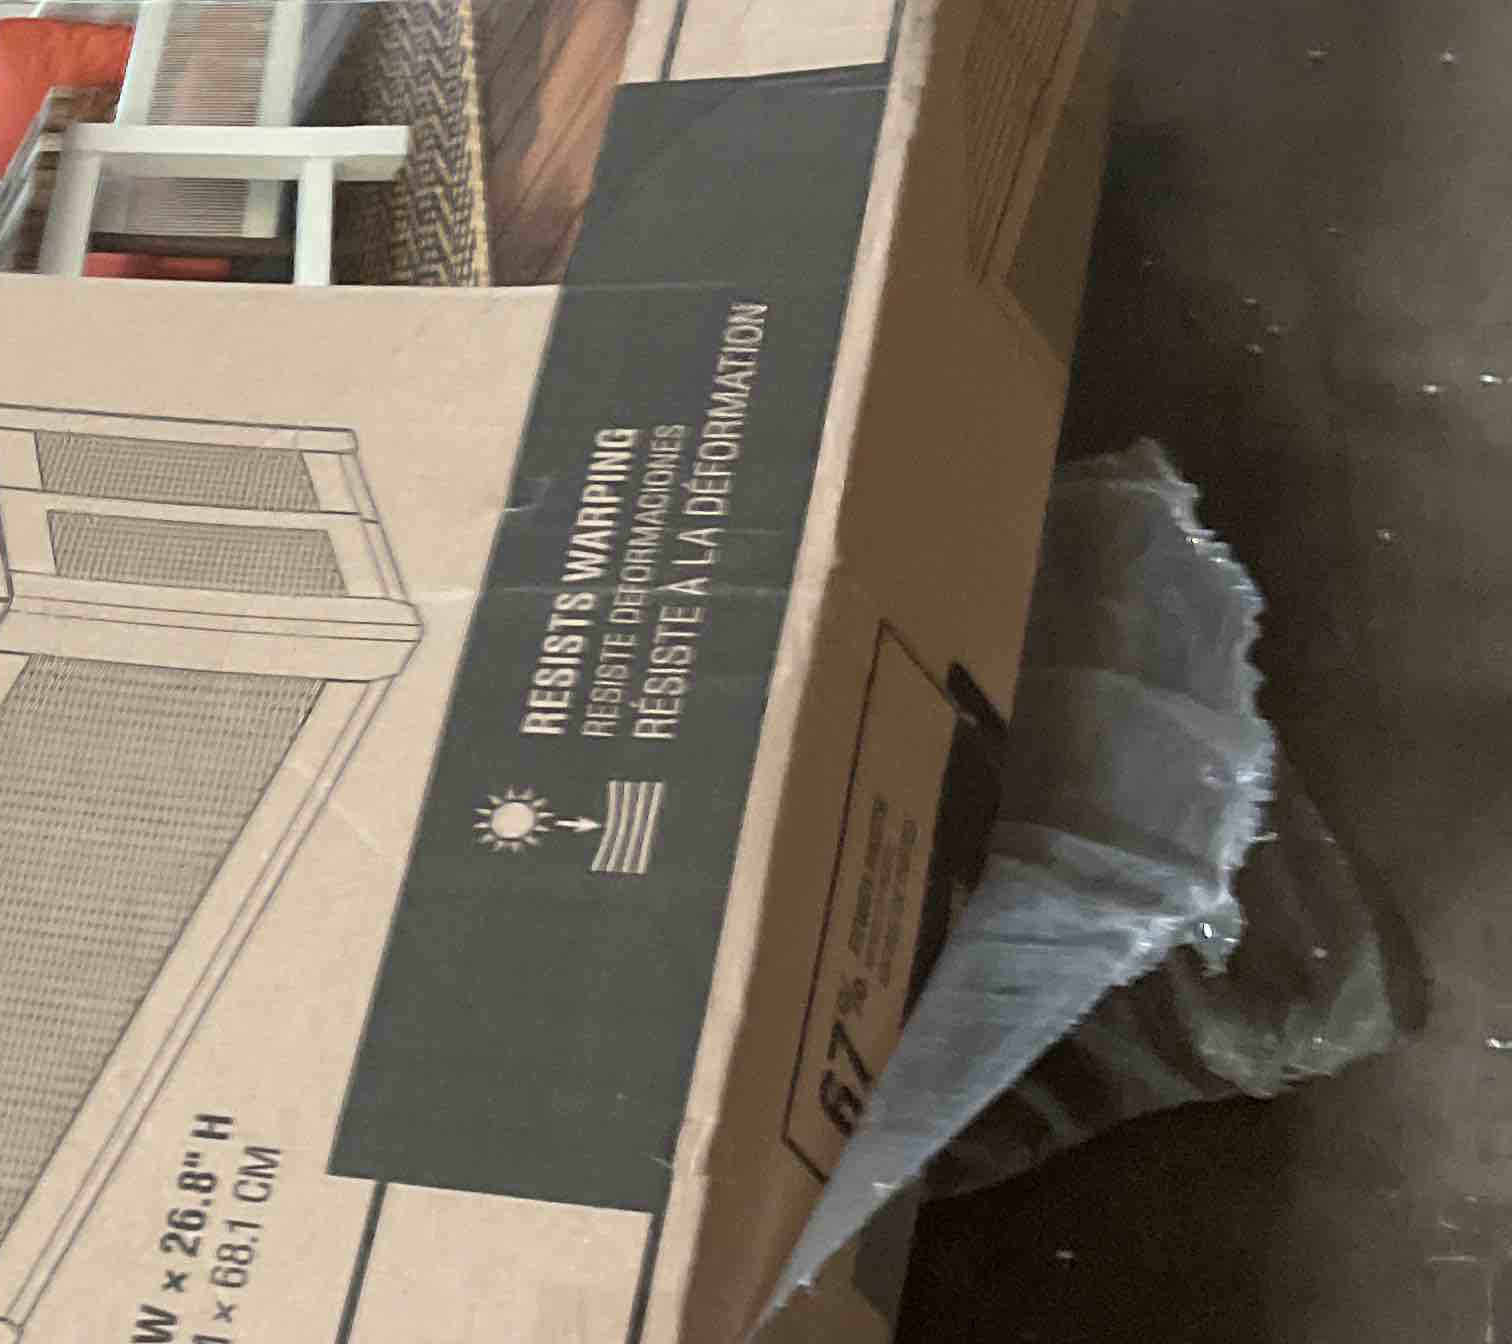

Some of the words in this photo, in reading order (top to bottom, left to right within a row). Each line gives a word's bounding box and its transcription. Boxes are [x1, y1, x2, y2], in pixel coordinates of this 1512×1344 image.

[683, 302, 768, 517] DÉFORMATION
[520, 589, 596, 736] RESISTS
[560, 426, 640, 583] WARPING
[609, 422, 687, 625] DEFORMACIONES
[671, 527, 726, 565] LA
[582, 631, 638, 737] RESISTE
[631, 605, 706, 740] RÉSISTE
[160, 1150, 219, 1259] 26.8"
[192, 1112, 236, 1142] H
[231, 1144, 282, 1207] CM
[208, 1217, 265, 1292] 68.1
